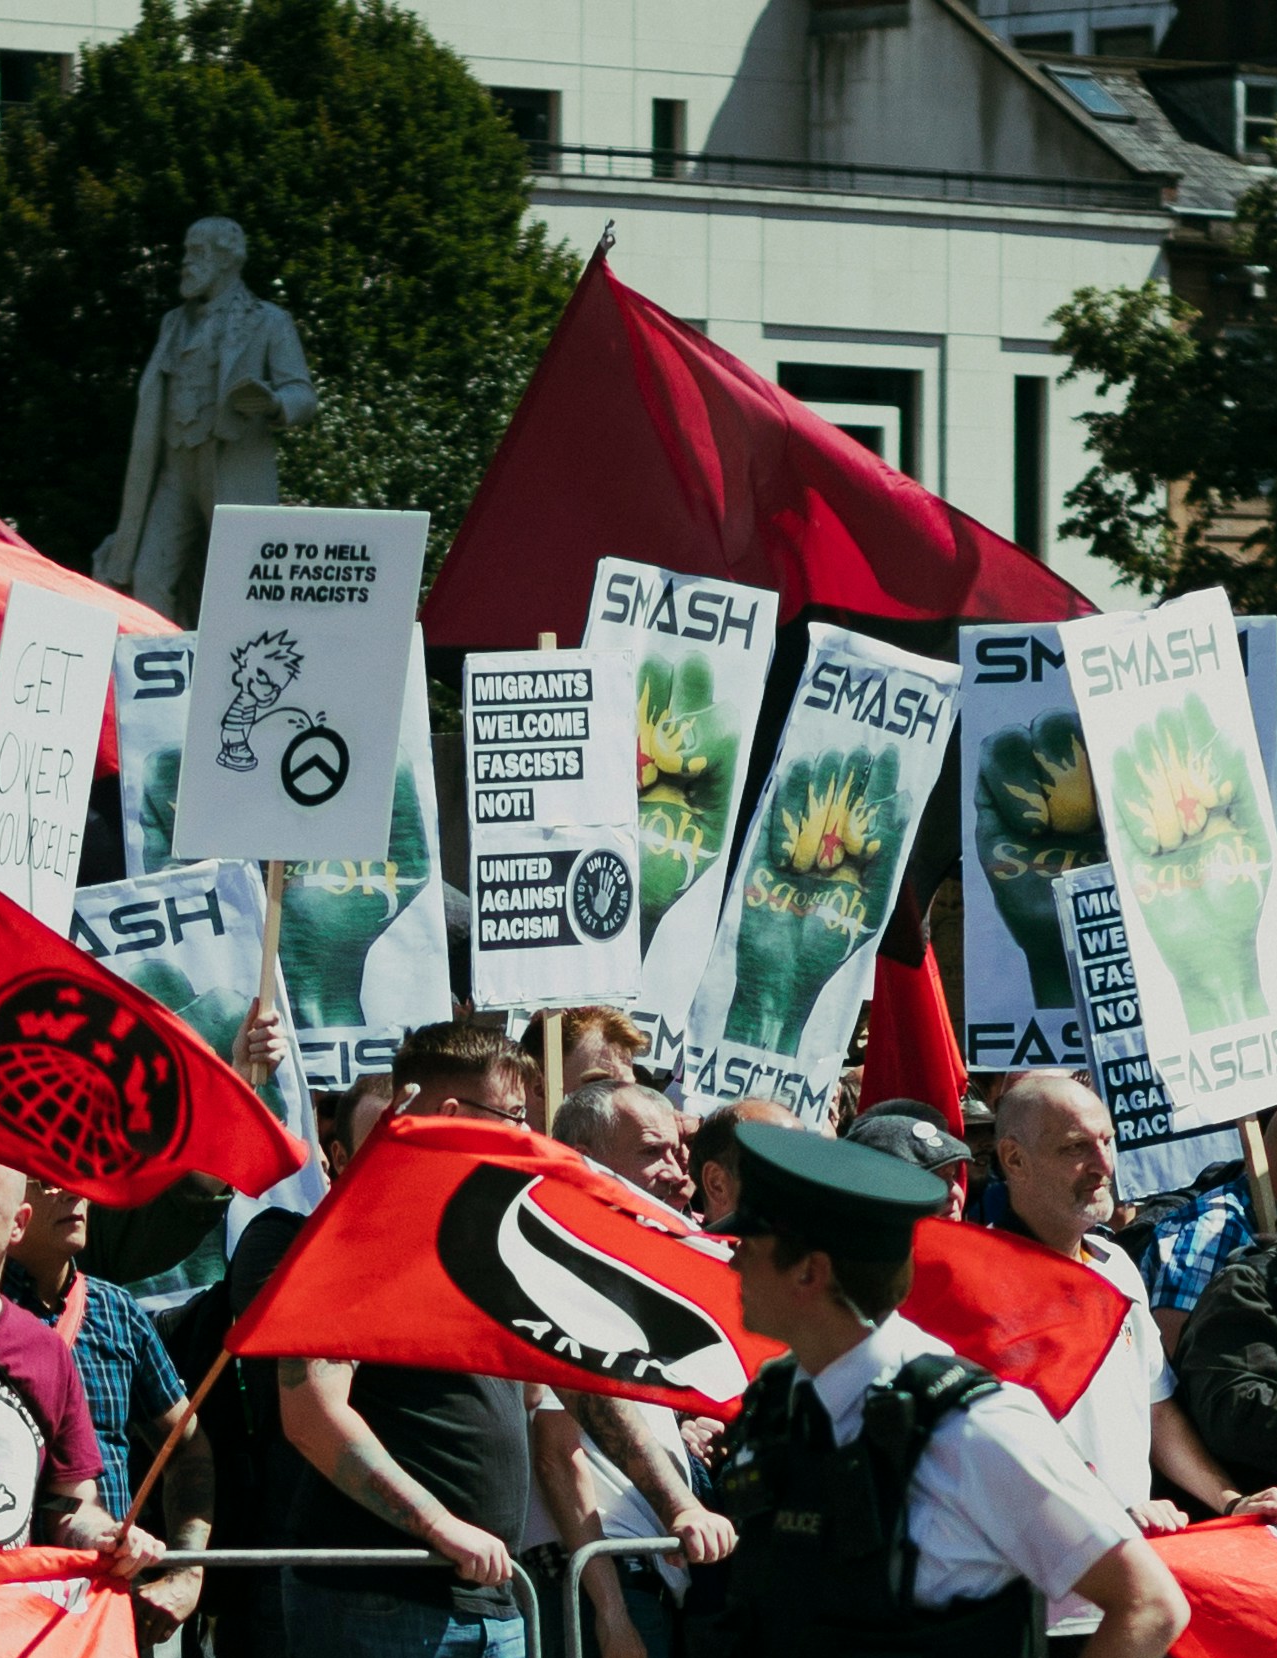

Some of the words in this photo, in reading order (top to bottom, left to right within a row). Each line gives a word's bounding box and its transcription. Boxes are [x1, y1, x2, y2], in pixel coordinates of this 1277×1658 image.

[260, 542, 289, 561] GO
[294, 543, 319, 561] TO
[324, 544, 371, 562] HELL
[249, 564, 284, 581] ALL
[289, 565, 377, 583] FASCISTS
[246, 584, 286, 601] AND
[290, 586, 370, 603] RACISTS
[601, 573, 759, 650] SMASH
[1081, 623, 1221, 698] SMASH
[12, 641, 84, 716] GET
[474, 673, 589, 702] MIGRANTS
[803, 661, 947, 744] SMASH
[475, 712, 586, 740] WELCOME
[477, 751, 580, 779] FASCISTS
[478, 792, 531, 818] NOT!
[481, 857, 552, 883] UNITED
[586, 856, 627, 886] UNITED
[481, 886, 565, 913] AGAINST
[482, 916, 560, 942] RACISM
